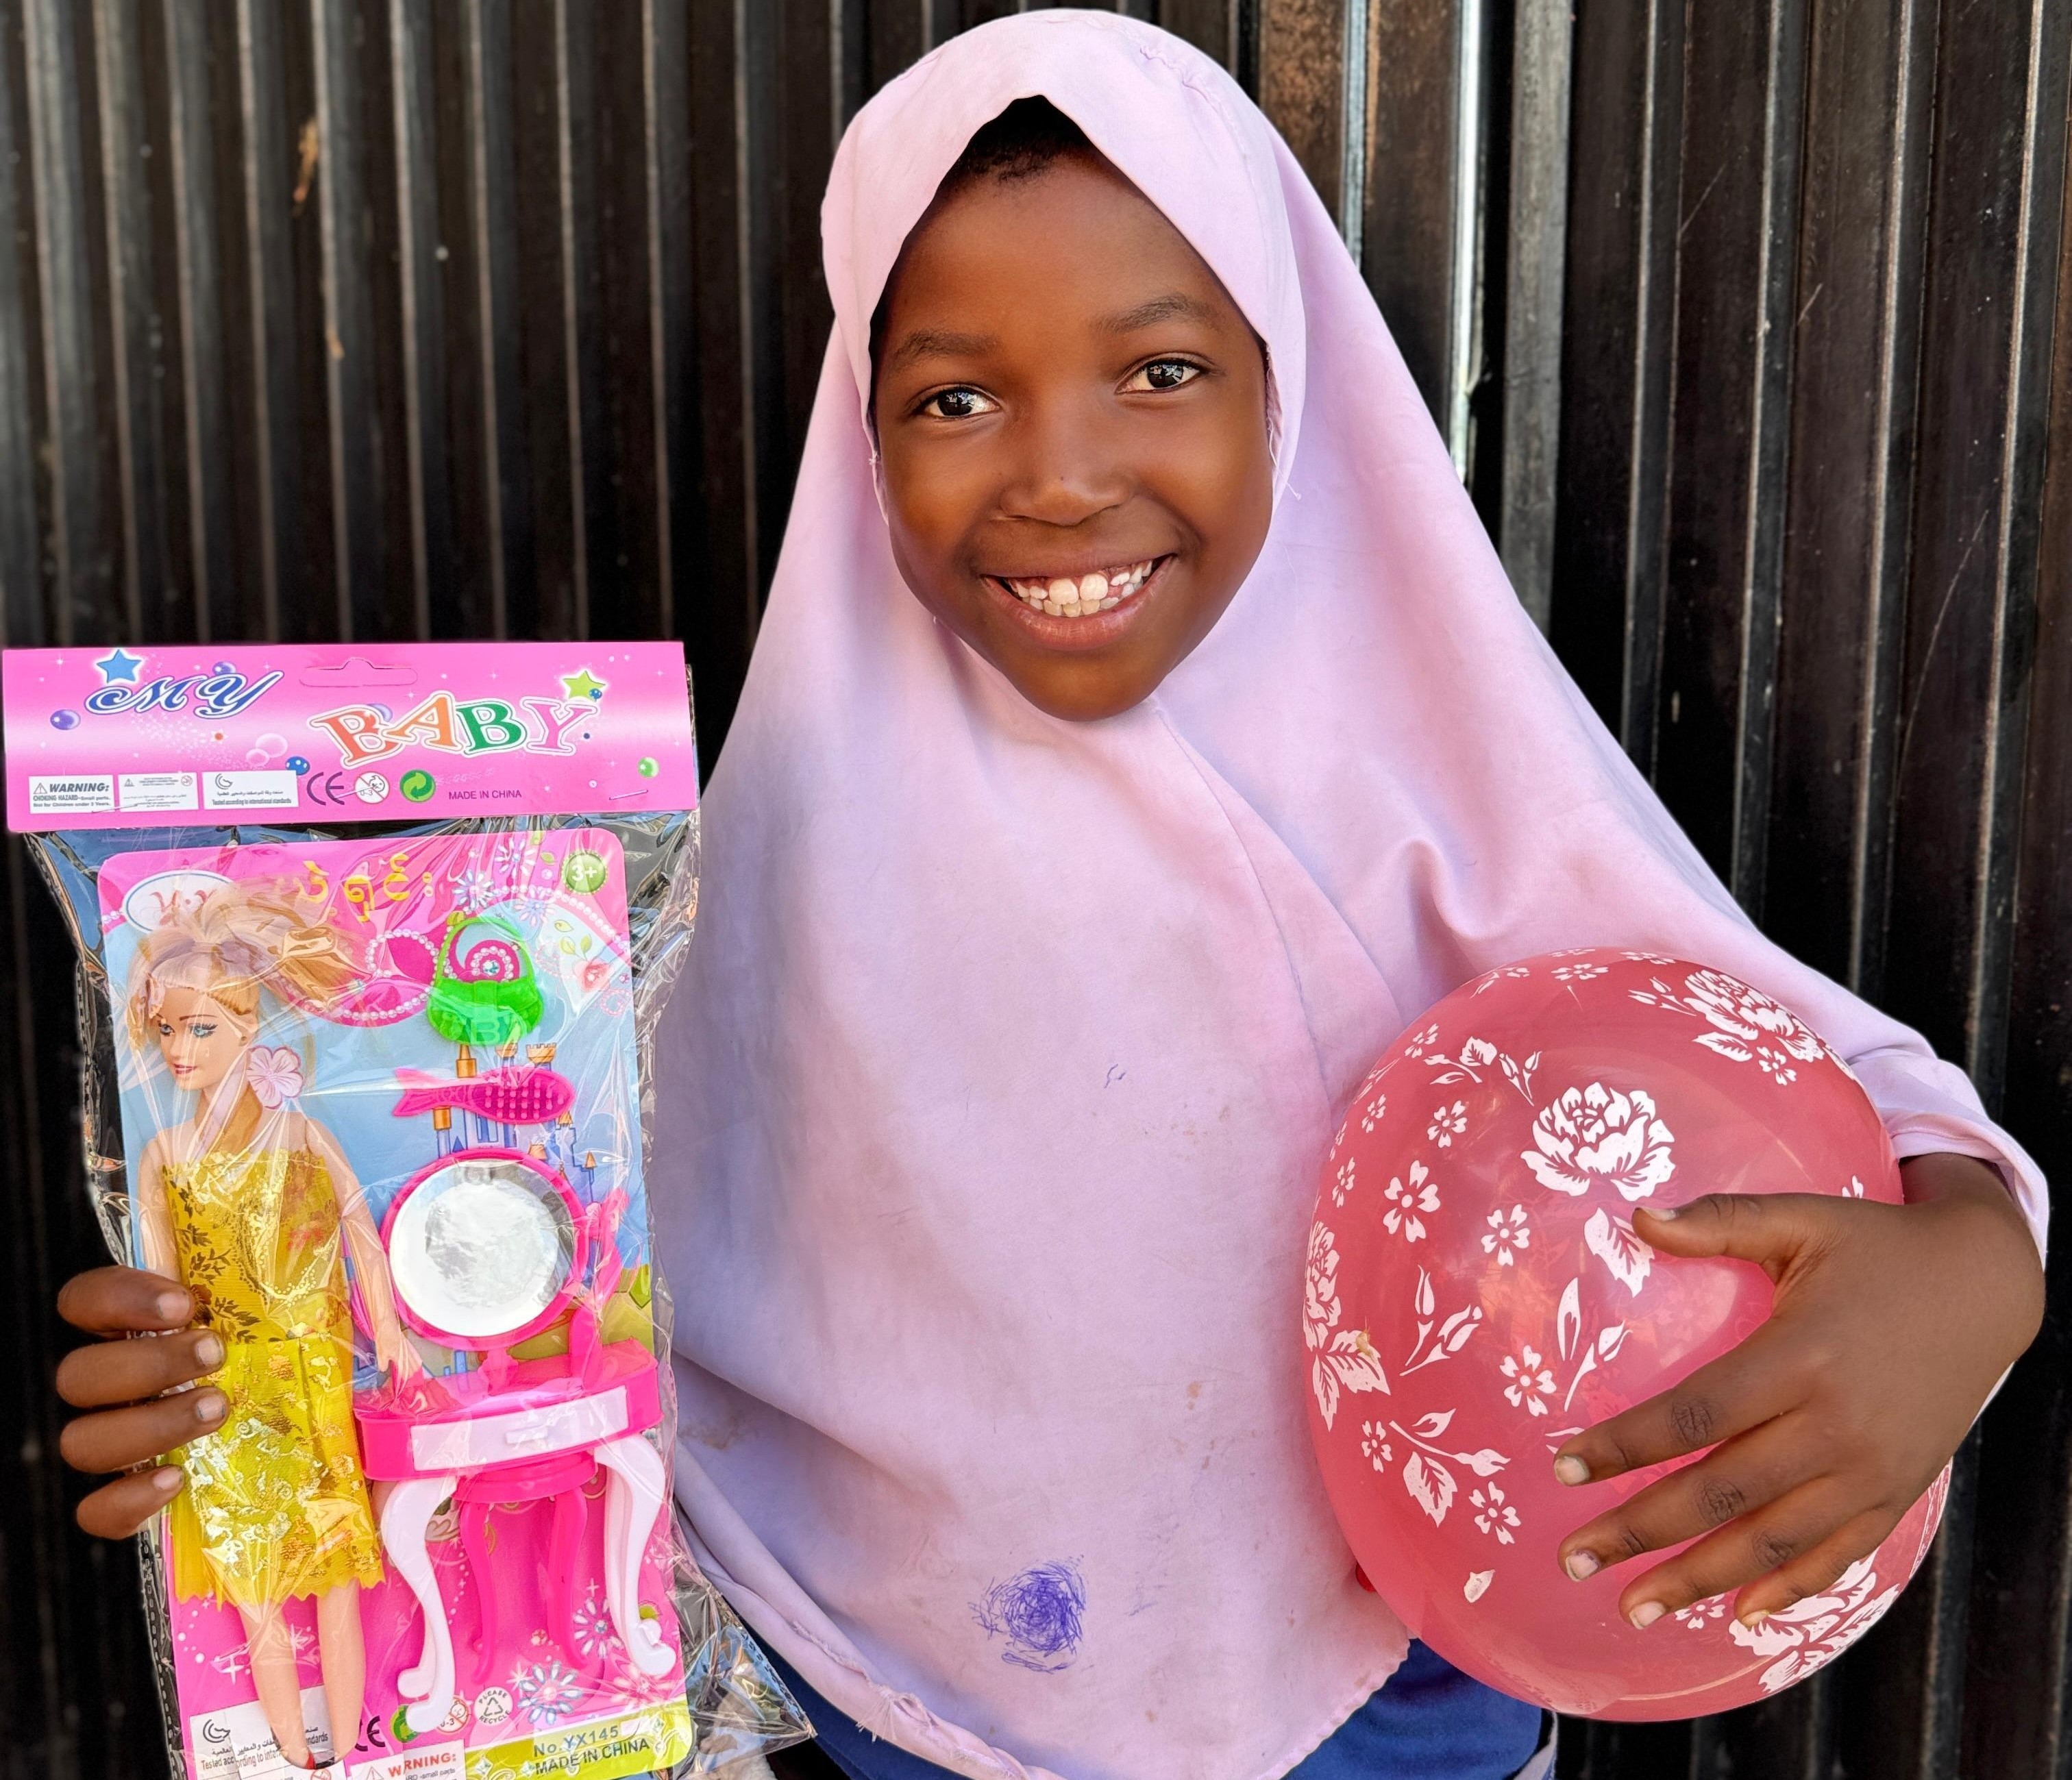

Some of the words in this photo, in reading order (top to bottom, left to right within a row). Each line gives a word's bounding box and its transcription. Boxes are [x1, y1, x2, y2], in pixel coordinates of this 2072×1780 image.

[85, 671, 284, 719] MY
[308, 691, 600, 770] BABY
[49, 783, 110, 793] WARNING:
[449, 791, 477, 800] MADE
[480, 791, 489, 799] IN
[492, 790, 522, 799] CHINA
[571, 864, 597, 882] 3+
[201, 1758, 222, 1770] Tested
[257, 1753, 264, 1763] to
[388, 1753, 456, 1777] WRNING:
[536, 1754, 580, 1775] MADE
[584, 1749, 598, 1764] IN
[602, 1738, 651, 1760] CHINA
